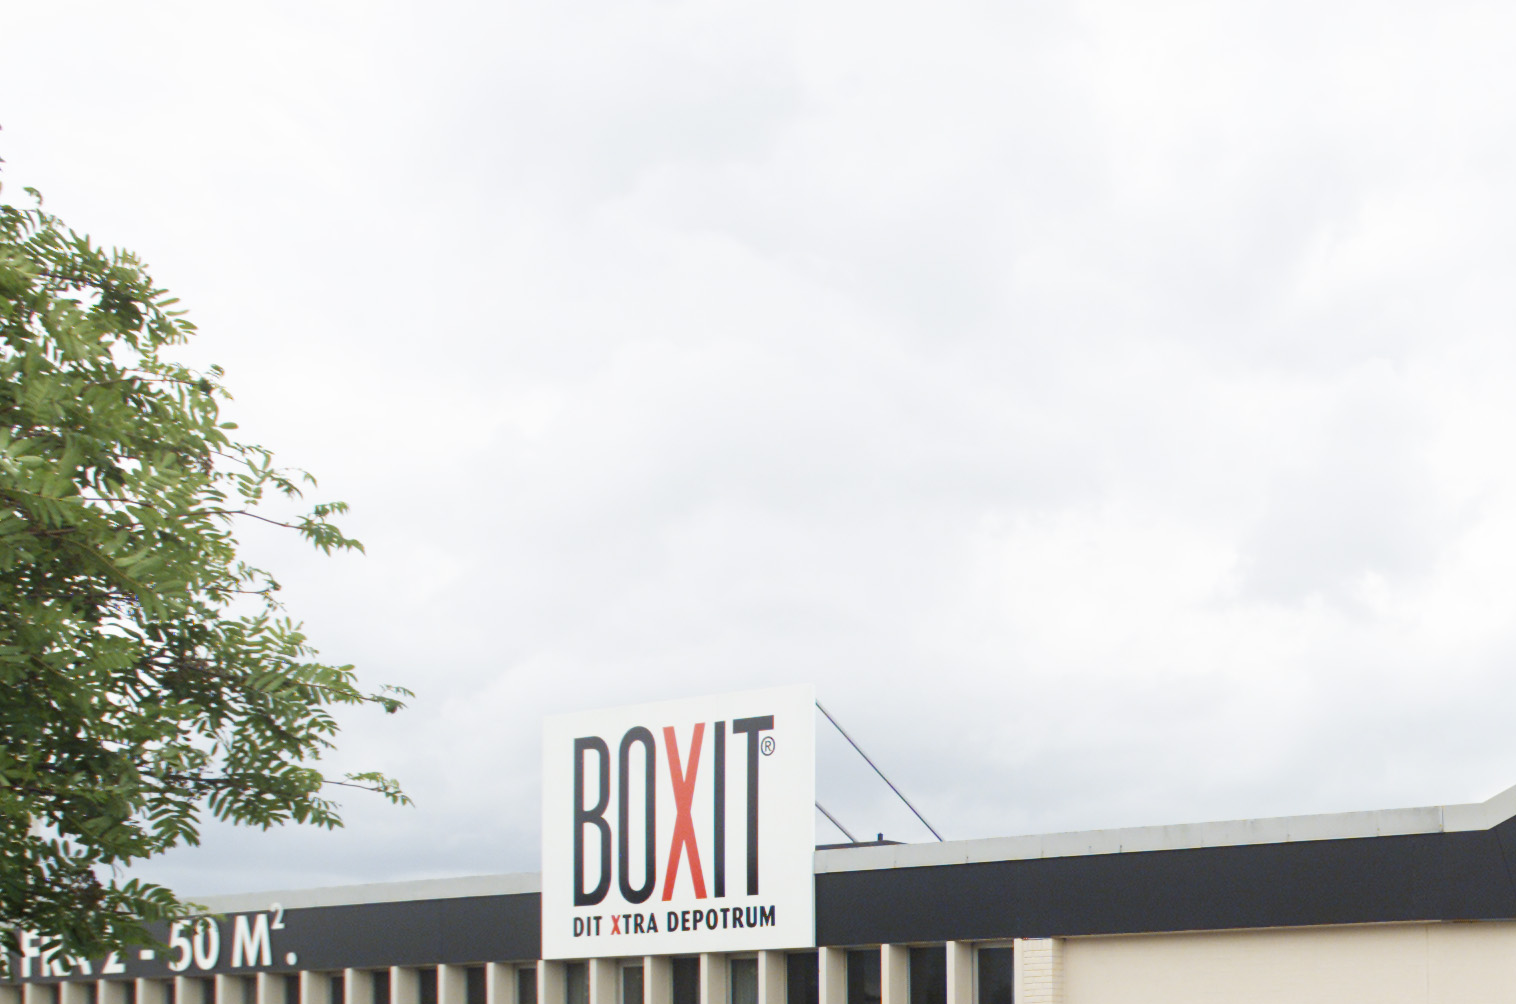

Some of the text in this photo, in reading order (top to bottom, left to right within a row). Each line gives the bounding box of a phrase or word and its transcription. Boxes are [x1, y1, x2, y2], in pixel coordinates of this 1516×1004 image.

[573, 714, 775, 907] BOXIT
[168, 916, 220, 972] 50
[573, 905, 776, 937] DIT XTRA DEPOTRUM
